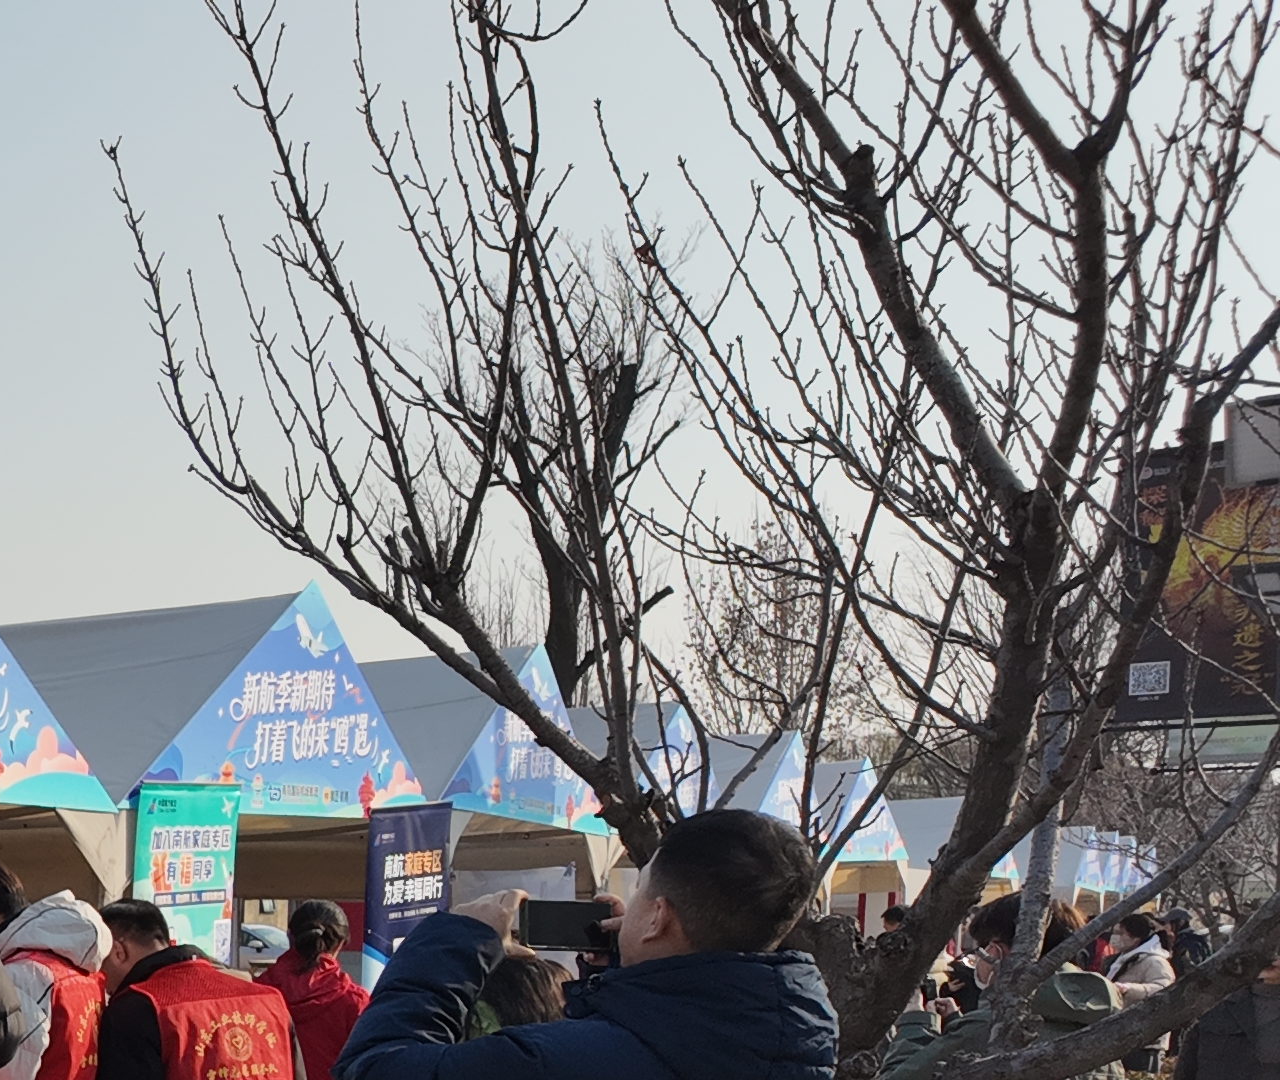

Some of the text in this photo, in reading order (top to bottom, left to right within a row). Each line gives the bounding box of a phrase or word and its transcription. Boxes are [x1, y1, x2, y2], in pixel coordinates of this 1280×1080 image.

[229, 669, 337, 721] 新航季新期待
